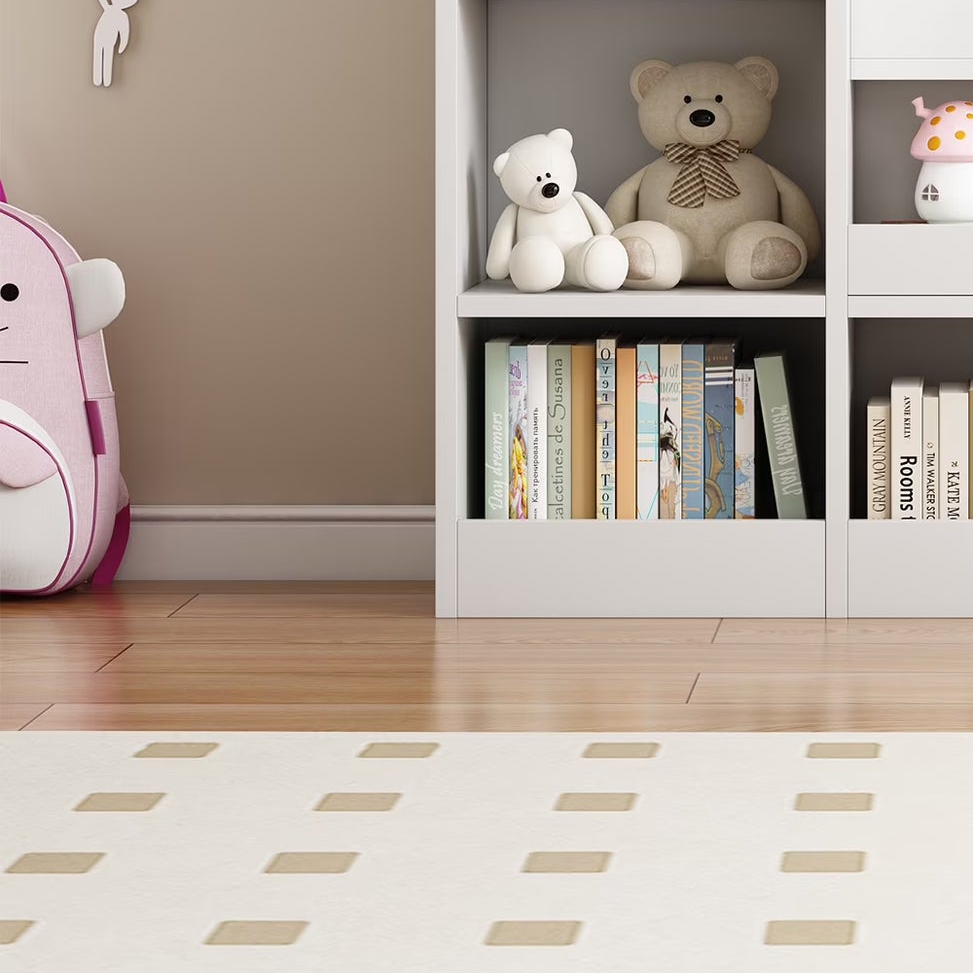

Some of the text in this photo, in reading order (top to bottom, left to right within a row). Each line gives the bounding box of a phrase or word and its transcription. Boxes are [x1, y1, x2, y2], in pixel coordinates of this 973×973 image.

[485, 412, 509, 510] Day dreamers
[547, 358, 566, 519] alcetines de Susana
[872, 418, 886, 512] GRAY MOUNTAIN
[926, 453, 935, 467] TIM
[900, 456, 918, 511] Rooms
[926, 469, 935, 504] WALKER
[947, 472, 960, 503] KATE
